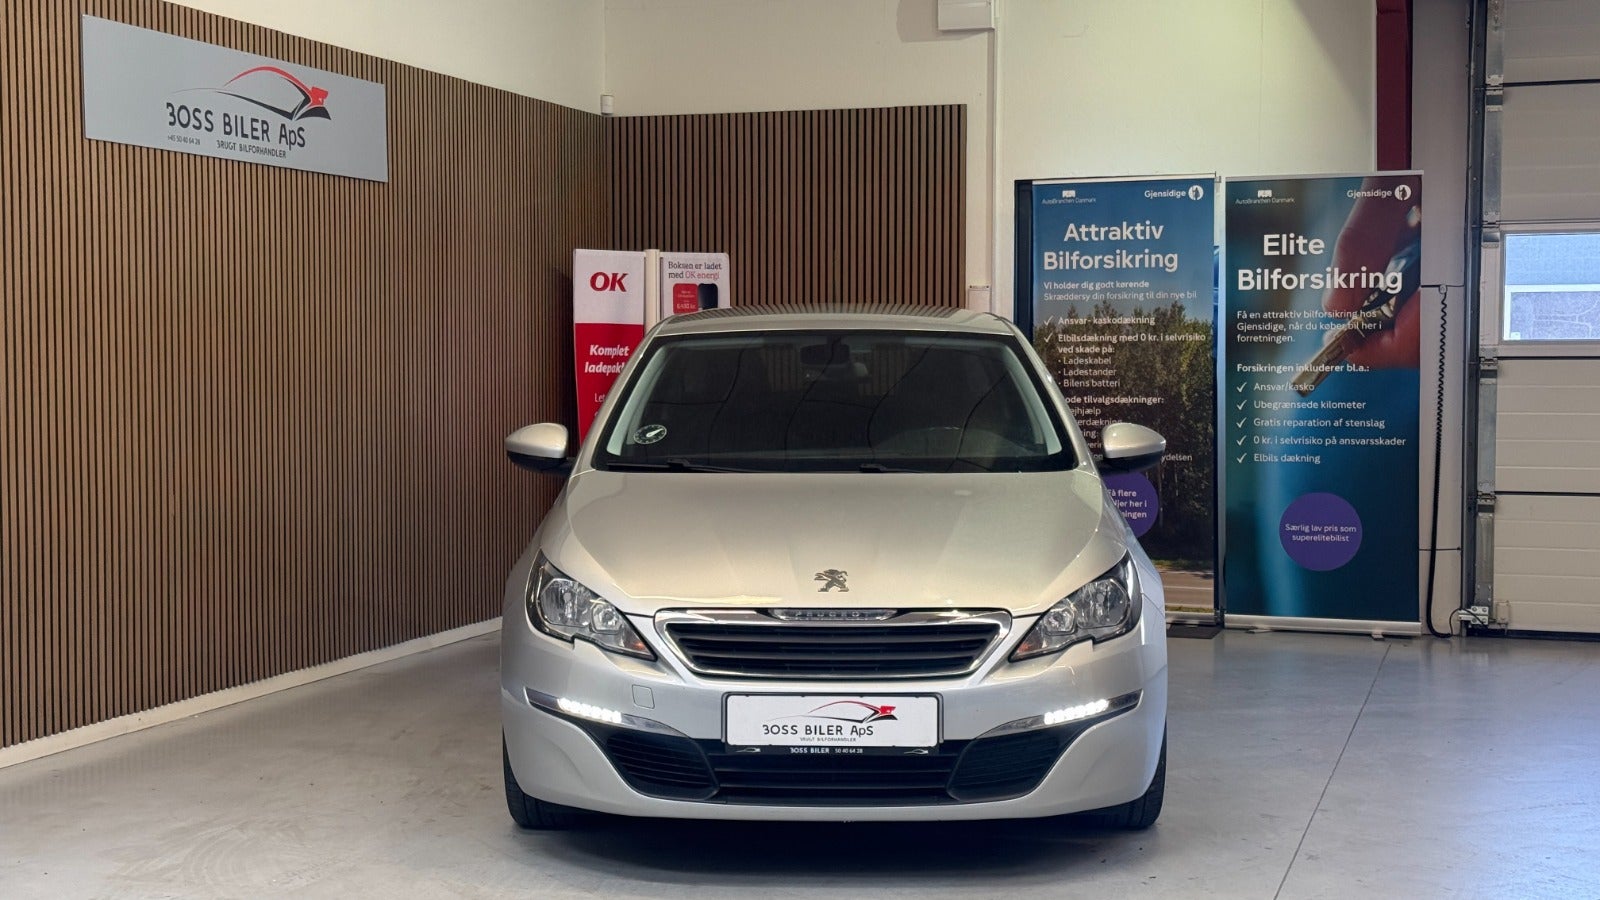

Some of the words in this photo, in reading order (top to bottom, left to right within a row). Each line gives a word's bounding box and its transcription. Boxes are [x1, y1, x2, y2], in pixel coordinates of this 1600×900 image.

[223, 113, 270, 142] BILER
[279, 123, 305, 150] ApS
[239, 143, 286, 158] BILFORHANDLER
[1144, 189, 1186, 199] Gjensidige
[1347, 190, 1392, 200] Gjensidige
[1064, 220, 1164, 242] Attraktiv
[1263, 233, 1325, 256] Elite
[668, 261, 693, 270] Boksen
[704, 262, 722, 270] ladet
[1043, 249, 1178, 272] Bilforsikring
[668, 271, 684, 279] med
[685, 271, 696, 279] OK
[697, 272, 719, 281] energi
[1238, 266, 1403, 294] Bilforsikring
[590, 271, 629, 292] OK
[1043, 282, 1052, 290] Vi
[1053, 281, 1079, 289] holder
[1081, 281, 1093, 290] dig
[1095, 281, 1114, 290] godt
[1115, 280, 1149, 288] kørende
[1044, 293, 1090, 302] Skræddersy
[1092, 292, 1105, 300] din
[1106, 292, 1144, 301] forsikring
[1158, 291, 1169, 299] din
[1186, 291, 1197, 299] bil
[1237, 310, 1247, 319] Få
[1263, 311, 1302, 319] attraktiv
[1304, 310, 1358, 320] bilforsikring
[1359, 310, 1376, 318] hos
[1058, 317, 1091, 325] Ansvar-
[1093, 316, 1156, 326] kaskodækning
[1237, 323, 1286, 333] Gjensidige,
[1289, 322, 1305, 330] når
[1306, 322, 1318, 330] du
[1058, 334, 1118, 344] Elbilsdækning
[1119, 334, 1139, 342] med
[1140, 334, 1146, 342] 0
[1148, 334, 1159, 342] kr.
[1165, 333, 1206, 341] selvrisiko
[1237, 334, 1295, 344] forretningen.
[590, 344, 630, 359] Komplet
[1102, 346, 1115, 354] på:
[1063, 368, 1117, 376] Ladestander
[1237, 364, 1293, 374] Forsikringen
[1296, 364, 1344, 372] inkluderer
[1347, 364, 1370, 372] bl.a.:
[1063, 380, 1090, 388] Bilens
[1254, 383, 1315, 392] Ansvar/kasko
[1084, 396, 1164, 405] tilvalgsdækninger:
[1254, 401, 1318, 410] Ubegrænsede
[1320, 401, 1366, 409] kilometer
[1254, 418, 1281, 426] Gratis
[1283, 419, 1331, 428] reparation
[1333, 418, 1343, 427] af
[1345, 419, 1385, 428] stenslag
[1254, 436, 1259, 444] 0
[1262, 436, 1273, 444] kr.
[1280, 436, 1323, 444] selvrisiko
[1325, 436, 1337, 446] på
[1339, 437, 1406, 446] ansvarsskader
[1254, 454, 1278, 462] Elbils
[1280, 454, 1321, 464] dækning
[1285, 524, 1310, 533] Særlig
[1324, 525, 1338, 533] pris
[1292, 534, 1349, 543] superelitebilist
[805, 725, 843, 735] BILER
[850, 726, 874, 738] ApS
